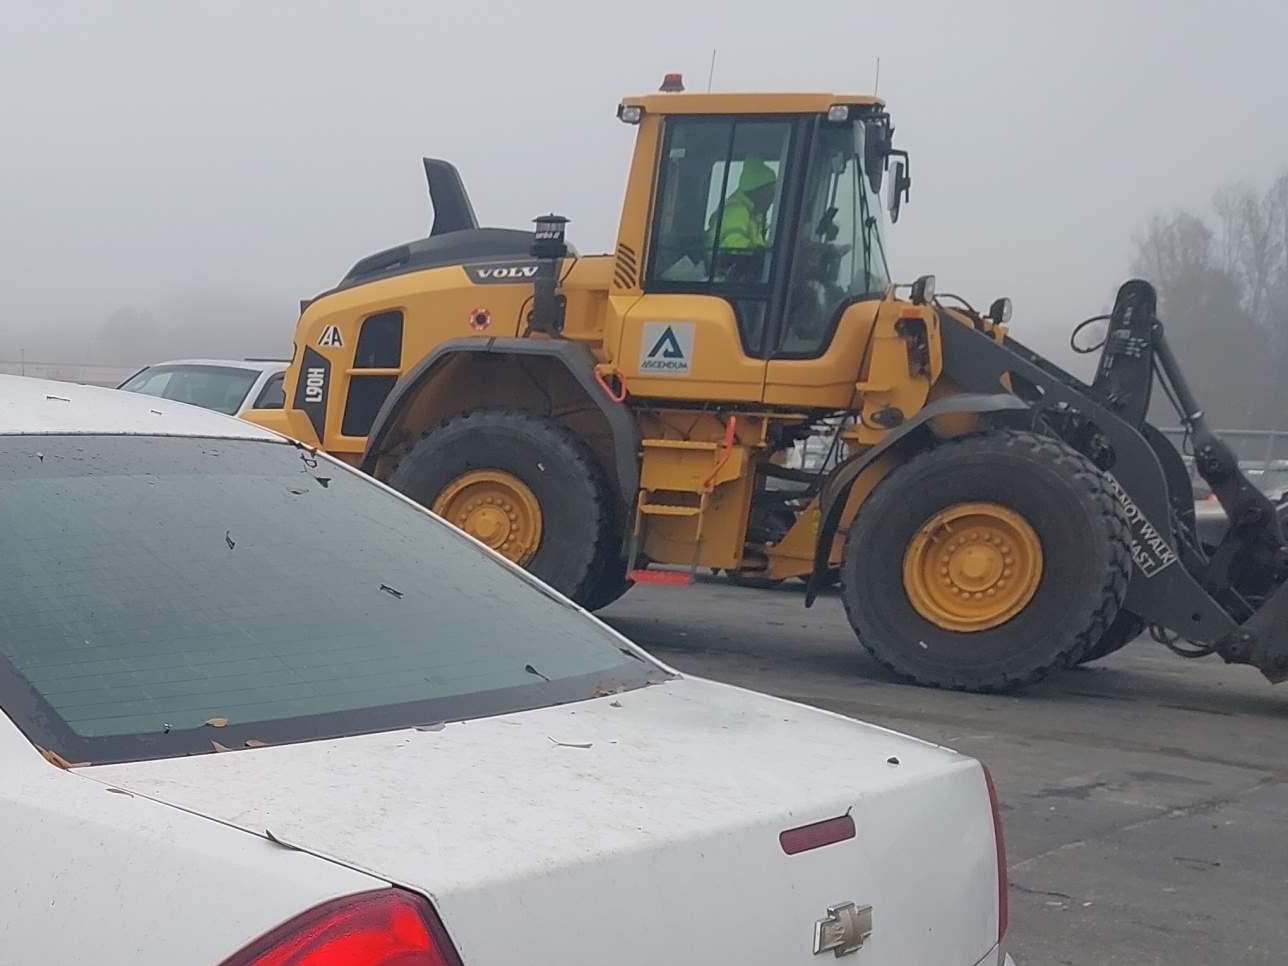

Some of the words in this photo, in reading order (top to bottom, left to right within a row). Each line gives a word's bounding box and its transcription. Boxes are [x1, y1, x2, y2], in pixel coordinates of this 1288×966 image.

[477, 266, 539, 278] VOLV
[305, 368, 325, 402] L90H
[1140, 522, 1175, 564] WALK
